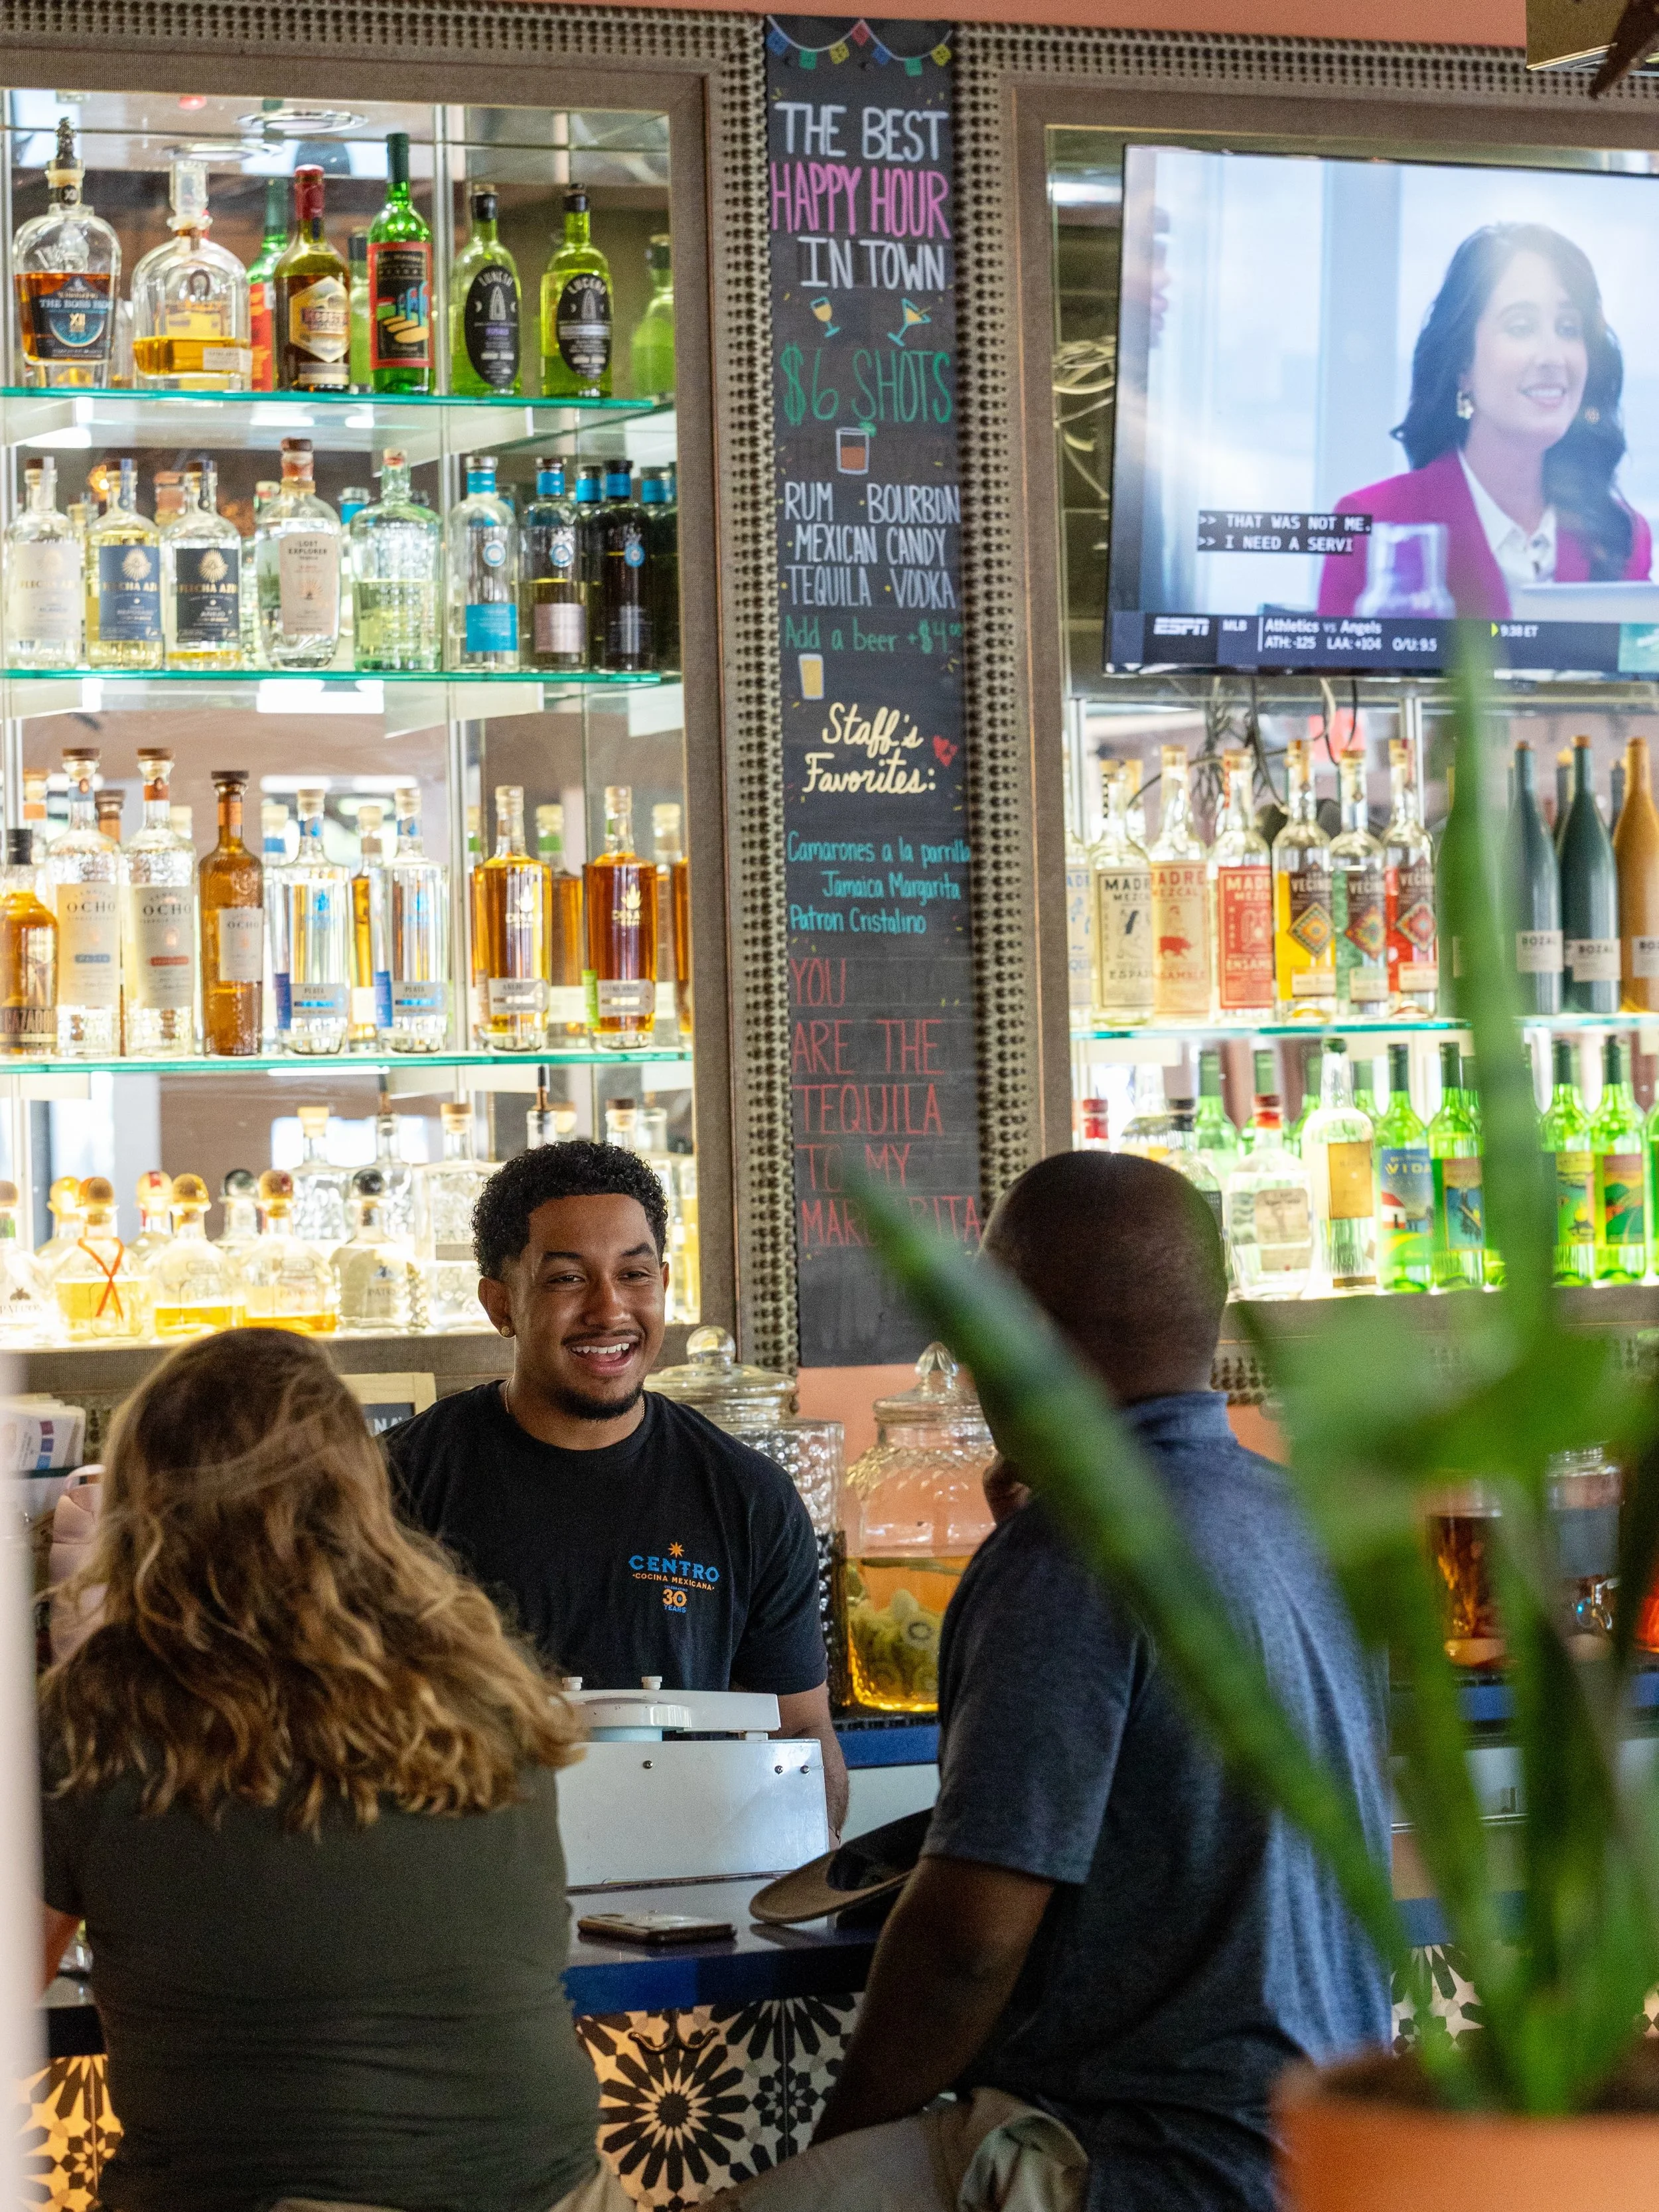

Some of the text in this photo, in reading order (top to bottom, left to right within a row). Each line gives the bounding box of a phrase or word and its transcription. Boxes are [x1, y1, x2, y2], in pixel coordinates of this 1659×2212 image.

[774, 102, 949, 163] THE BEST
[770, 161, 951, 239] HAPPY HOUR
[797, 236, 945, 291] IN TOWN
[780, 342, 952, 425] $6 SHOTS
[784, 482, 961, 524] RUM BOURBON
[1226, 514, 1263, 529] THAT
[1271, 514, 1301, 530] WAS
[1308, 516, 1337, 531] NOT
[1344, 516, 1371, 532] ME.
[796, 524, 946, 567] MEXICAN CANDY
[1225, 534, 1234, 550] I
[1242, 536, 1282, 550] NEED
[1288, 536, 1299, 550] A
[786, 565, 956, 609] TEQUILA VODKA
[784, 615, 820, 650] Add
[831, 628, 843, 650] a
[853, 617, 899, 652] beer
[1153, 617, 1248, 636] ESPN MLB
[1265, 618, 1319, 633] Athletics
[1340, 619, 1382, 636] Angels
[822, 702, 924, 759] Staff's
[802, 748, 936, 793] Favorites:
[786, 830, 971, 873] Camarones a la parrilla
[67, 902, 115, 913] OCHO
[821, 869, 962, 907] Jamaica Margarita
[143, 904, 191, 916] OCHO
[789, 903, 927, 935] Patron Cristalino
[790, 957, 847, 1007] YOU
[791, 1019, 945, 1075] ARE THE
[791, 1083, 944, 1136] TEQUILA
[865, 1142, 912, 1189] MY
[628, 1554, 720, 1583] CENTRO
[635, 1572, 712, 1591] COCINA MEXICANA
[662, 1588, 687, 1607] 30
[664, 1603, 687, 1613] YEARS
